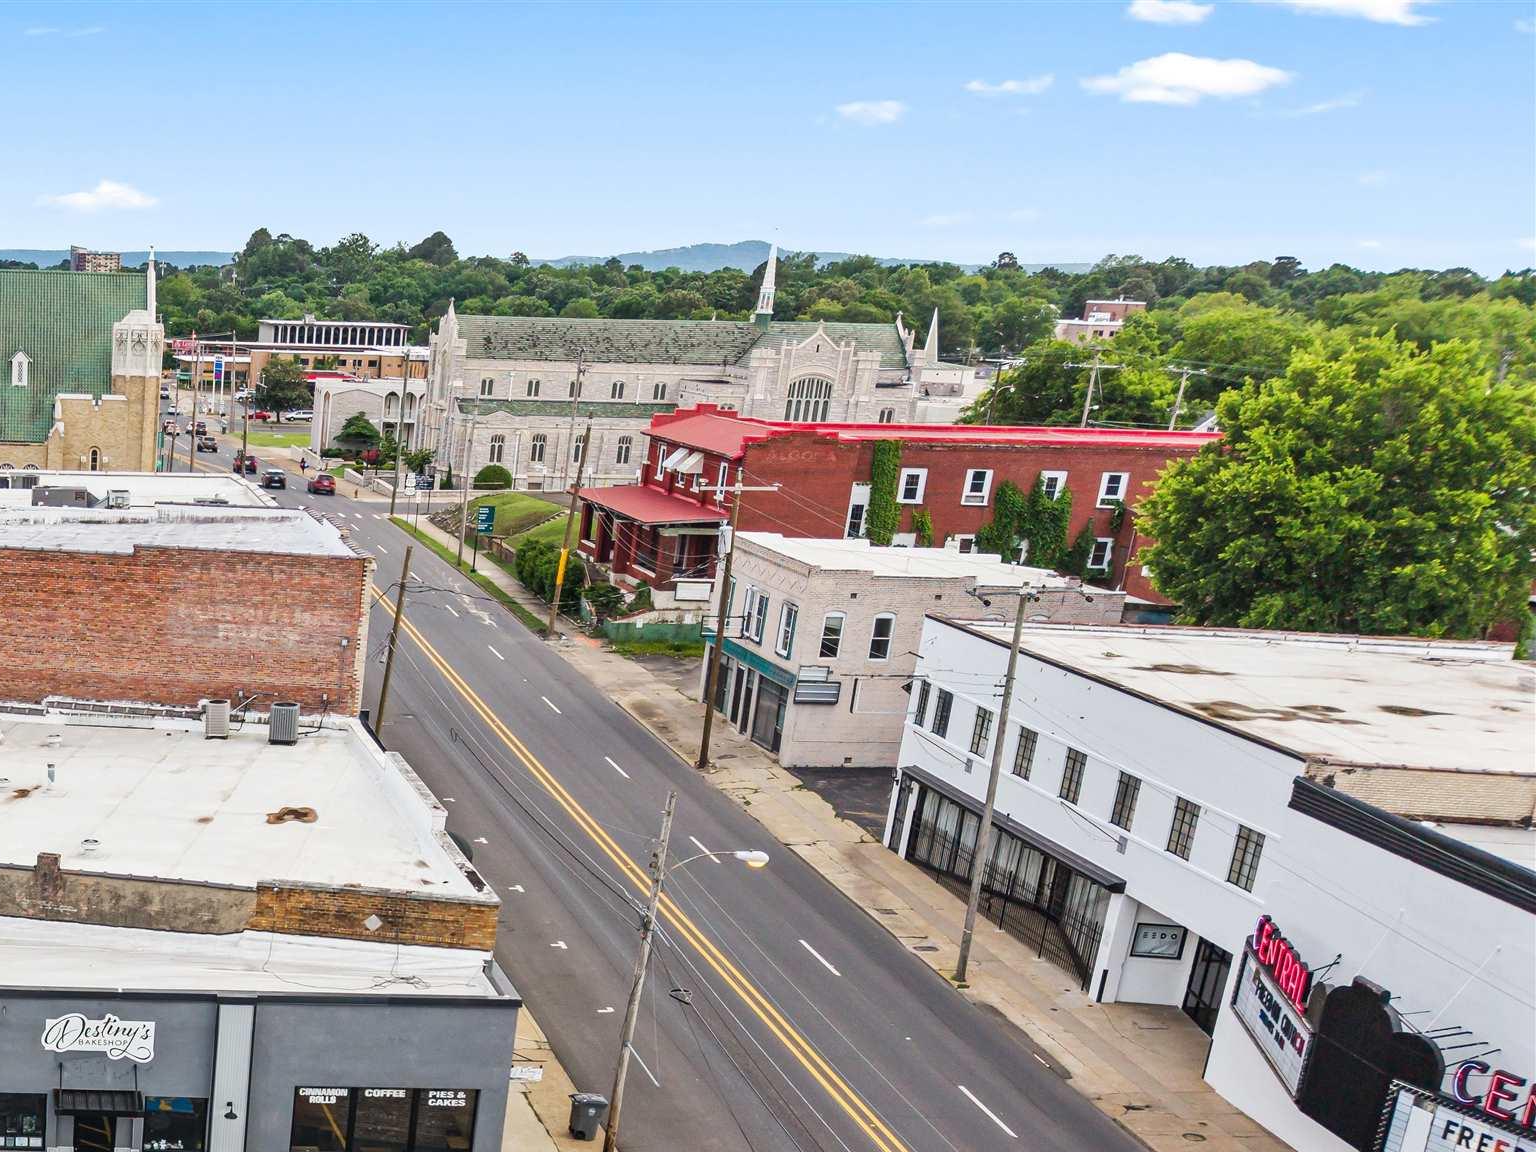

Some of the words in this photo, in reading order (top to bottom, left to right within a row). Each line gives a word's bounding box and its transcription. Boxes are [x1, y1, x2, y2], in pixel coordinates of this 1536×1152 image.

[1253, 915, 1310, 1013] CENTRAL
[44, 1015, 152, 1060] Destiny's
[299, 1088, 348, 1097] CINNAMON
[364, 1089, 406, 1098] COFFEE
[428, 1091, 454, 1099] PIES
[456, 1091, 467, 1099] &
[309, 1096, 337, 1104] ROLLS
[428, 1099, 466, 1107] CAKES
